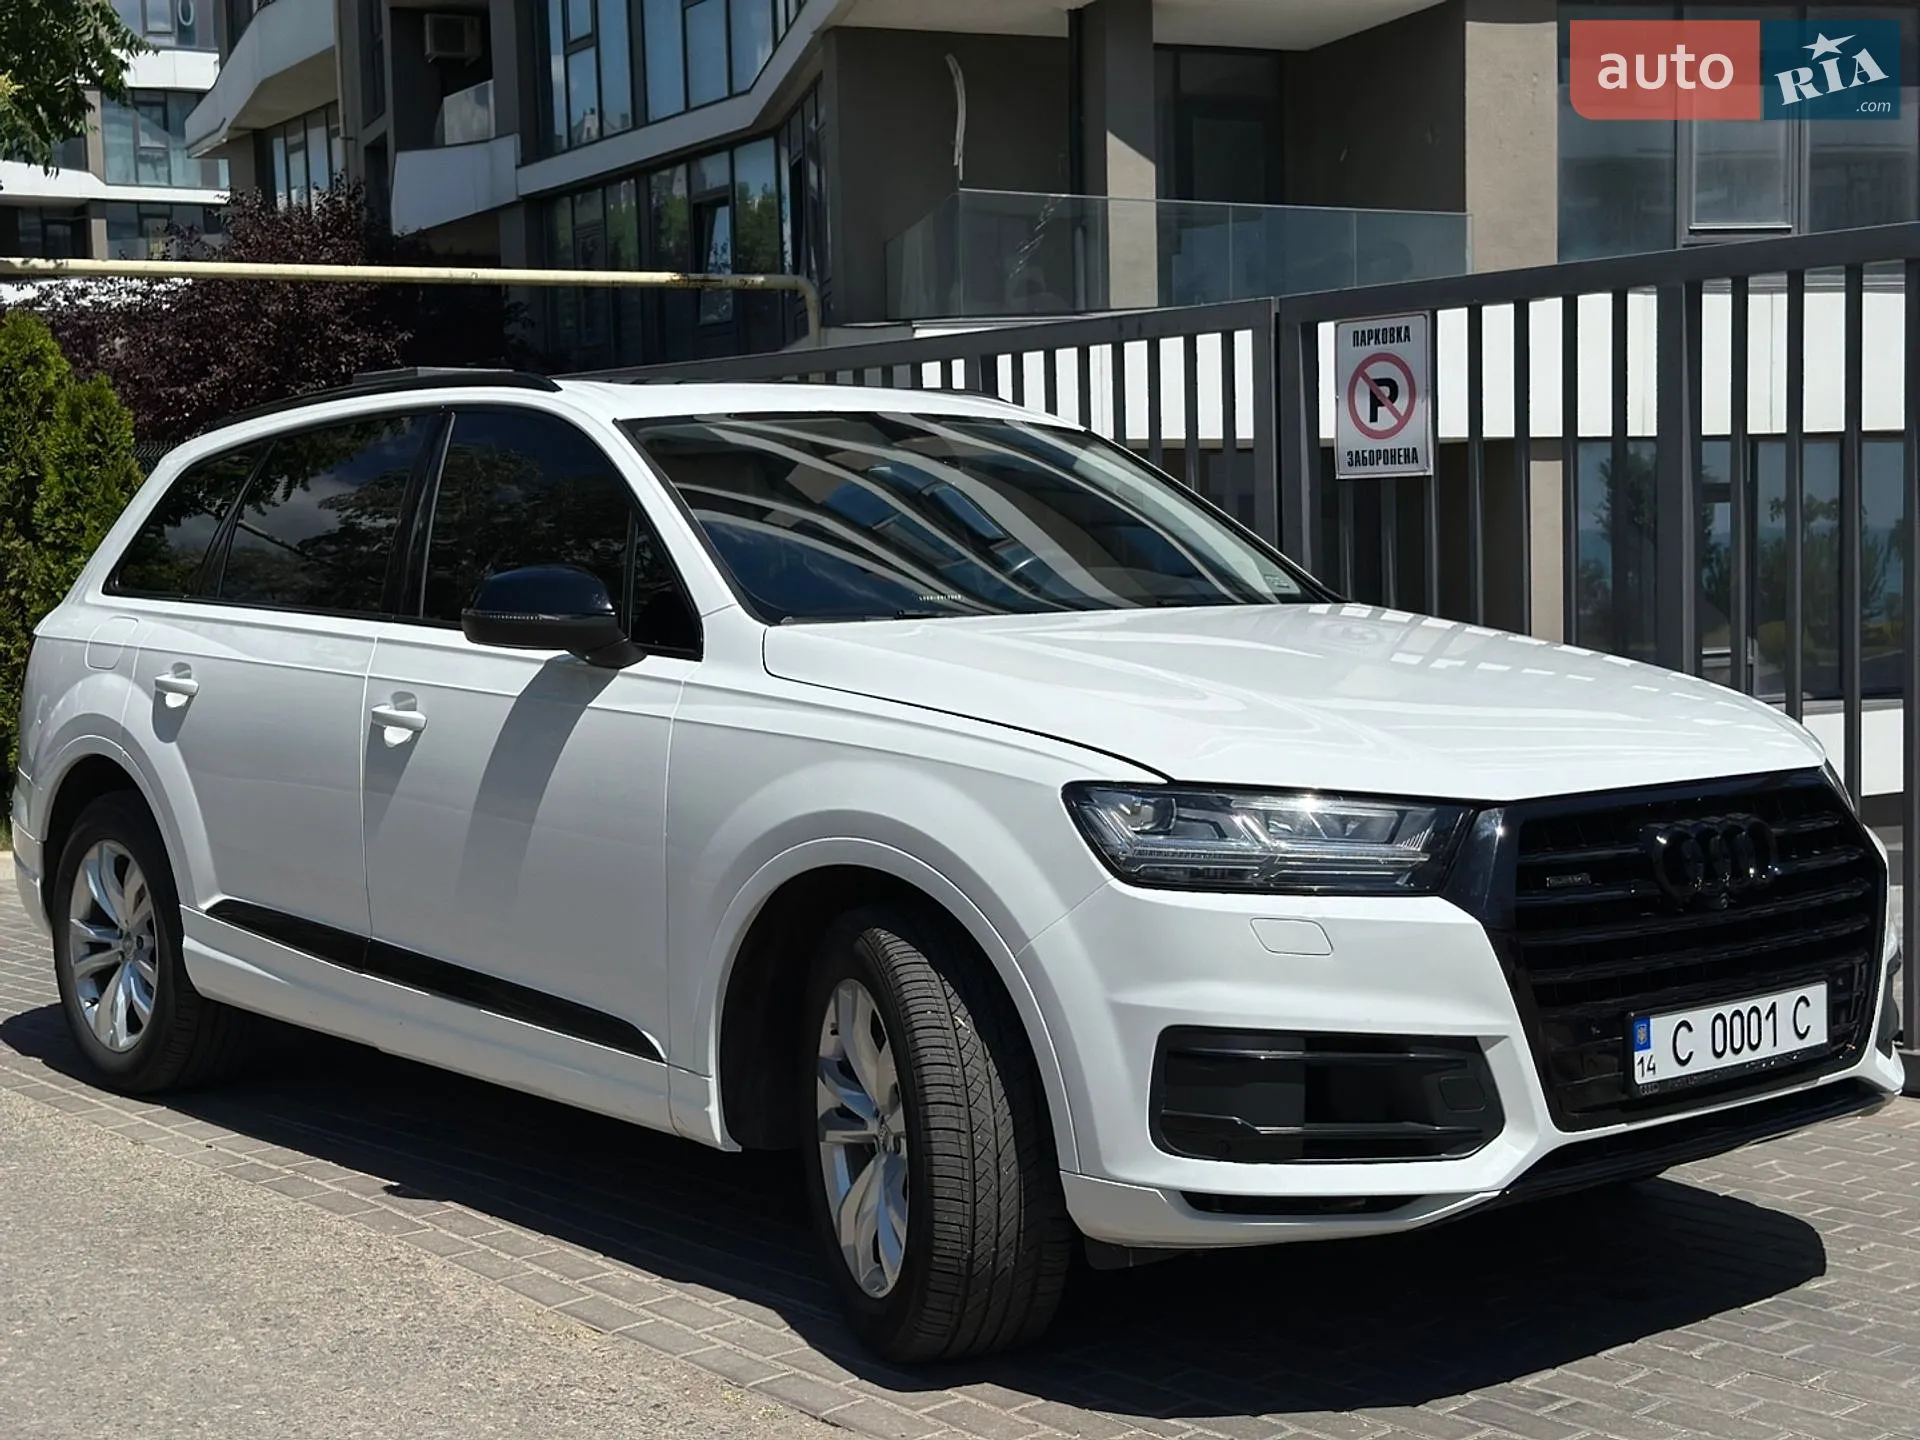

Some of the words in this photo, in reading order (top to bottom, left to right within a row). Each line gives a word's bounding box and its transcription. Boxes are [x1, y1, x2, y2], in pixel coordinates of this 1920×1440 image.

[1352, 325, 1411, 348] ПАРКОВКА
[1346, 447, 1419, 467] ЗАБОРОНЕНА
[1672, 1019, 1694, 1067] C
[1711, 1001, 1778, 1059] 0001
[1793, 995, 1811, 1040] C
[1636, 1054, 1657, 1078] 14
